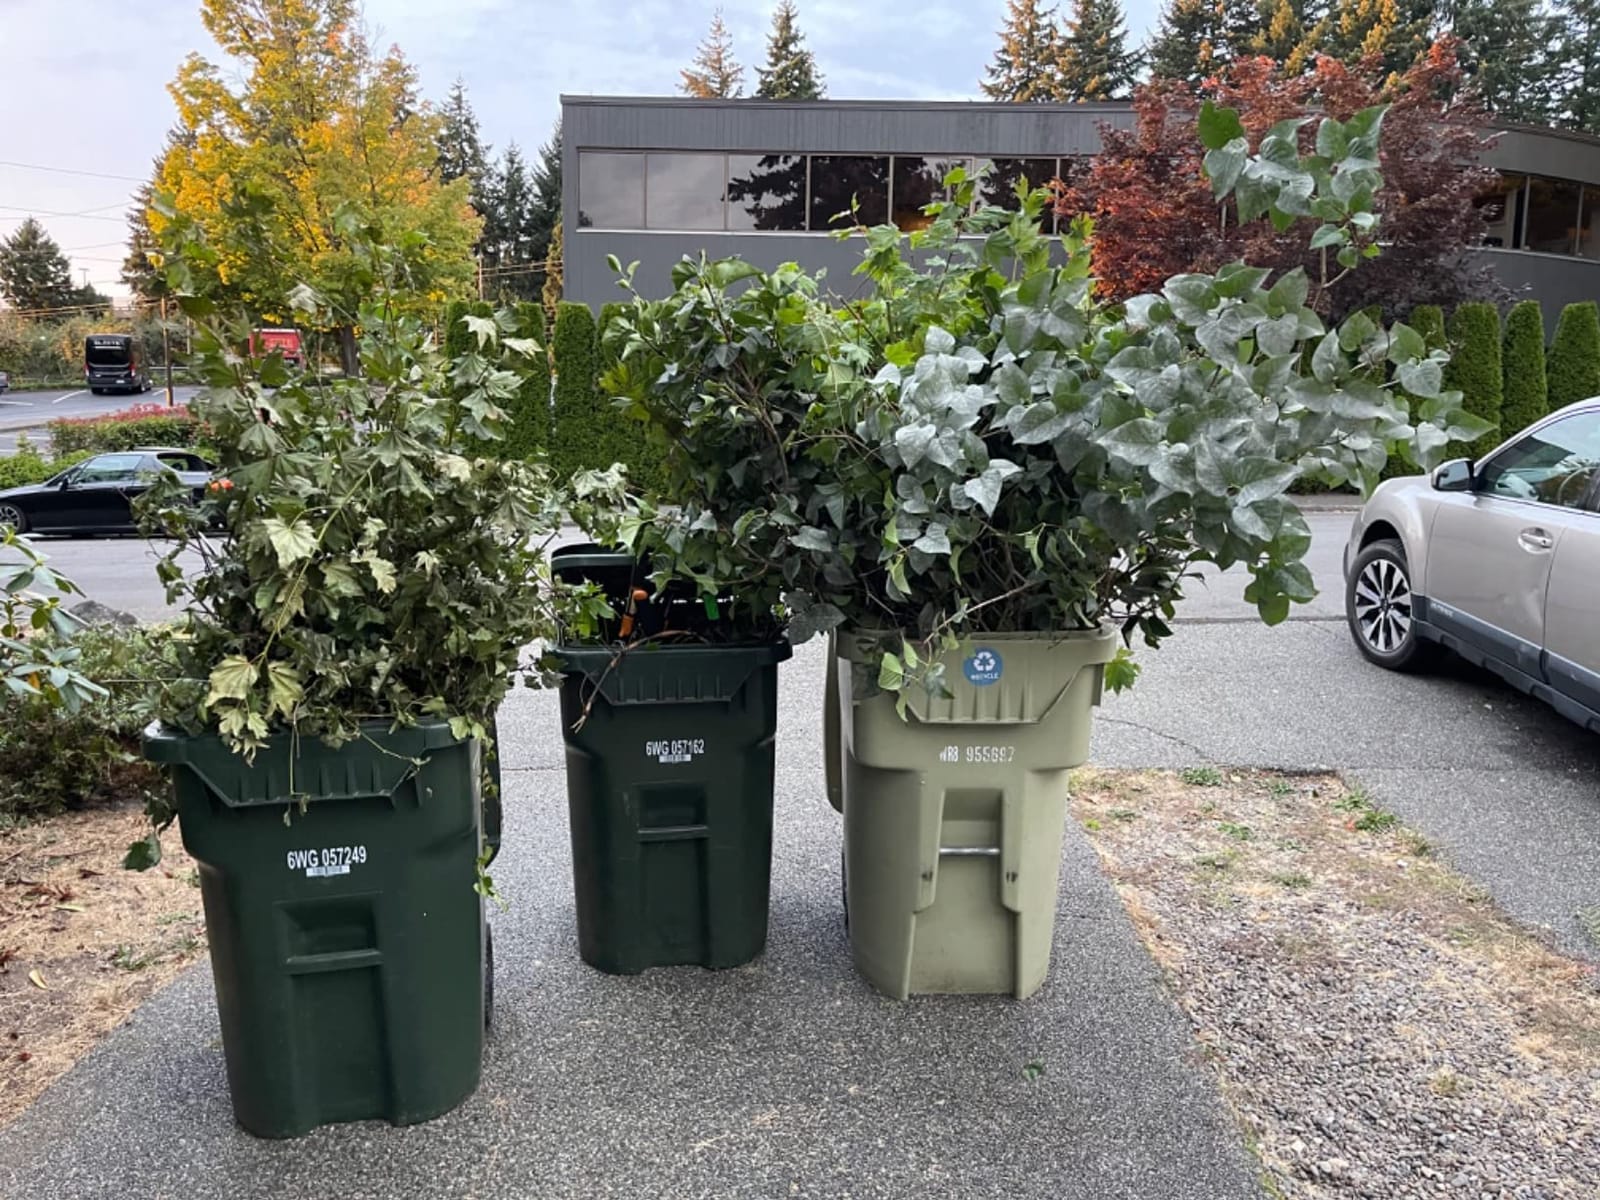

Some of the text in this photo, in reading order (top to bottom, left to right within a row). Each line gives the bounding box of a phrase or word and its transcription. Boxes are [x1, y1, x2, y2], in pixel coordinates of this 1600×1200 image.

[645, 741, 669, 756] 6WG
[287, 845, 367, 870] 6WG 057249
